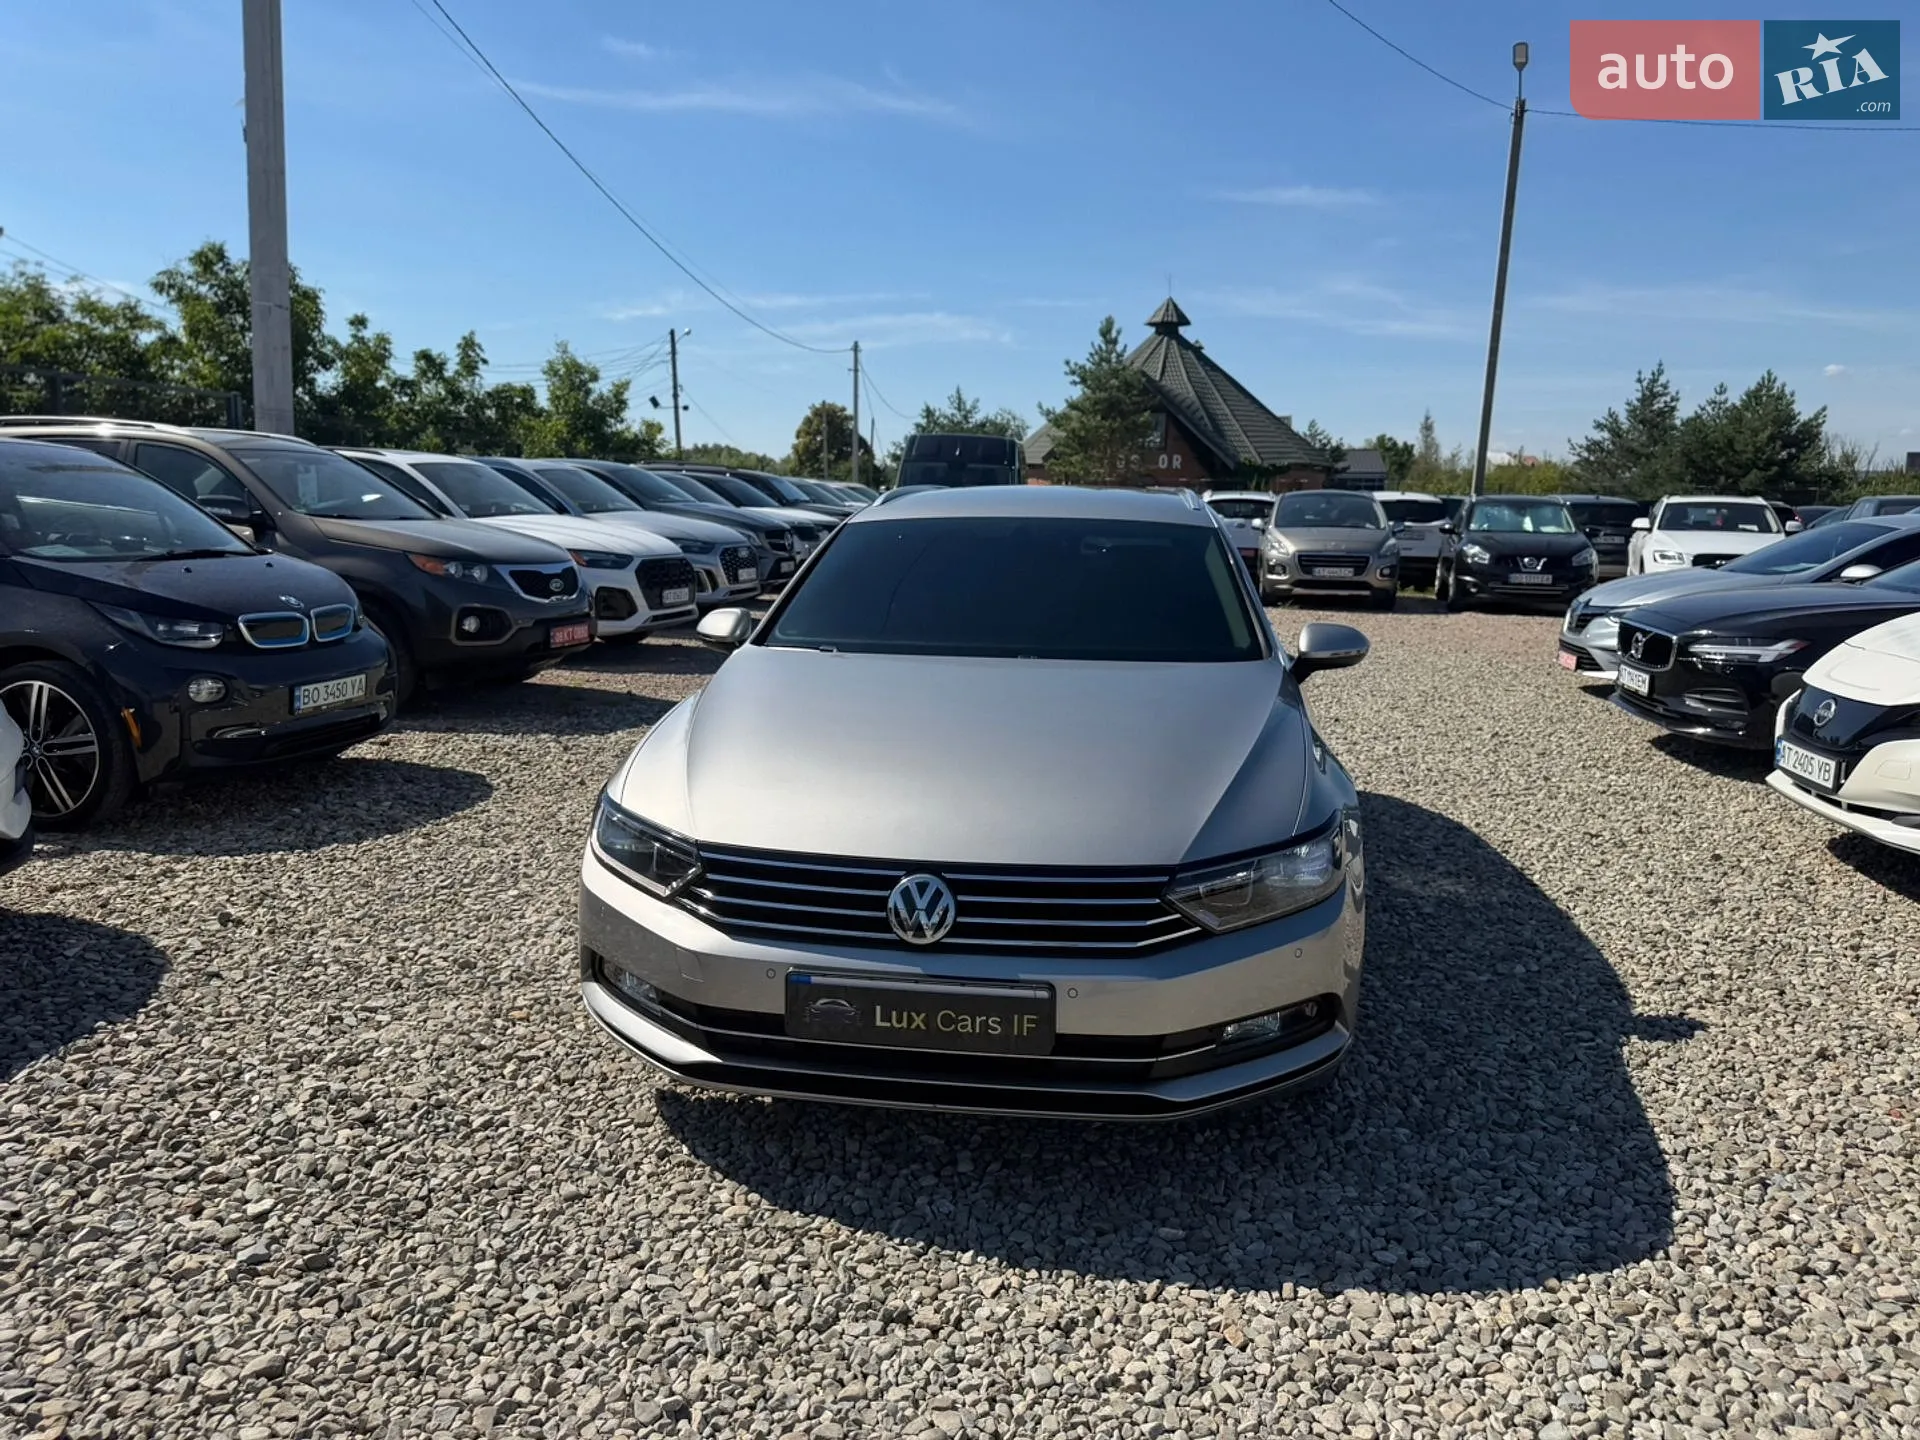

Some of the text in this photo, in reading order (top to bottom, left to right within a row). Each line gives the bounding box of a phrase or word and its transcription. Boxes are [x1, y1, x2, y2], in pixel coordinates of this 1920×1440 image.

[302, 677, 365, 706] BO 3450 YA
[1793, 750, 1815, 775] 2405
[1817, 760, 1831, 782] YB
[874, 1005, 1039, 1037] Lux Cars IF
